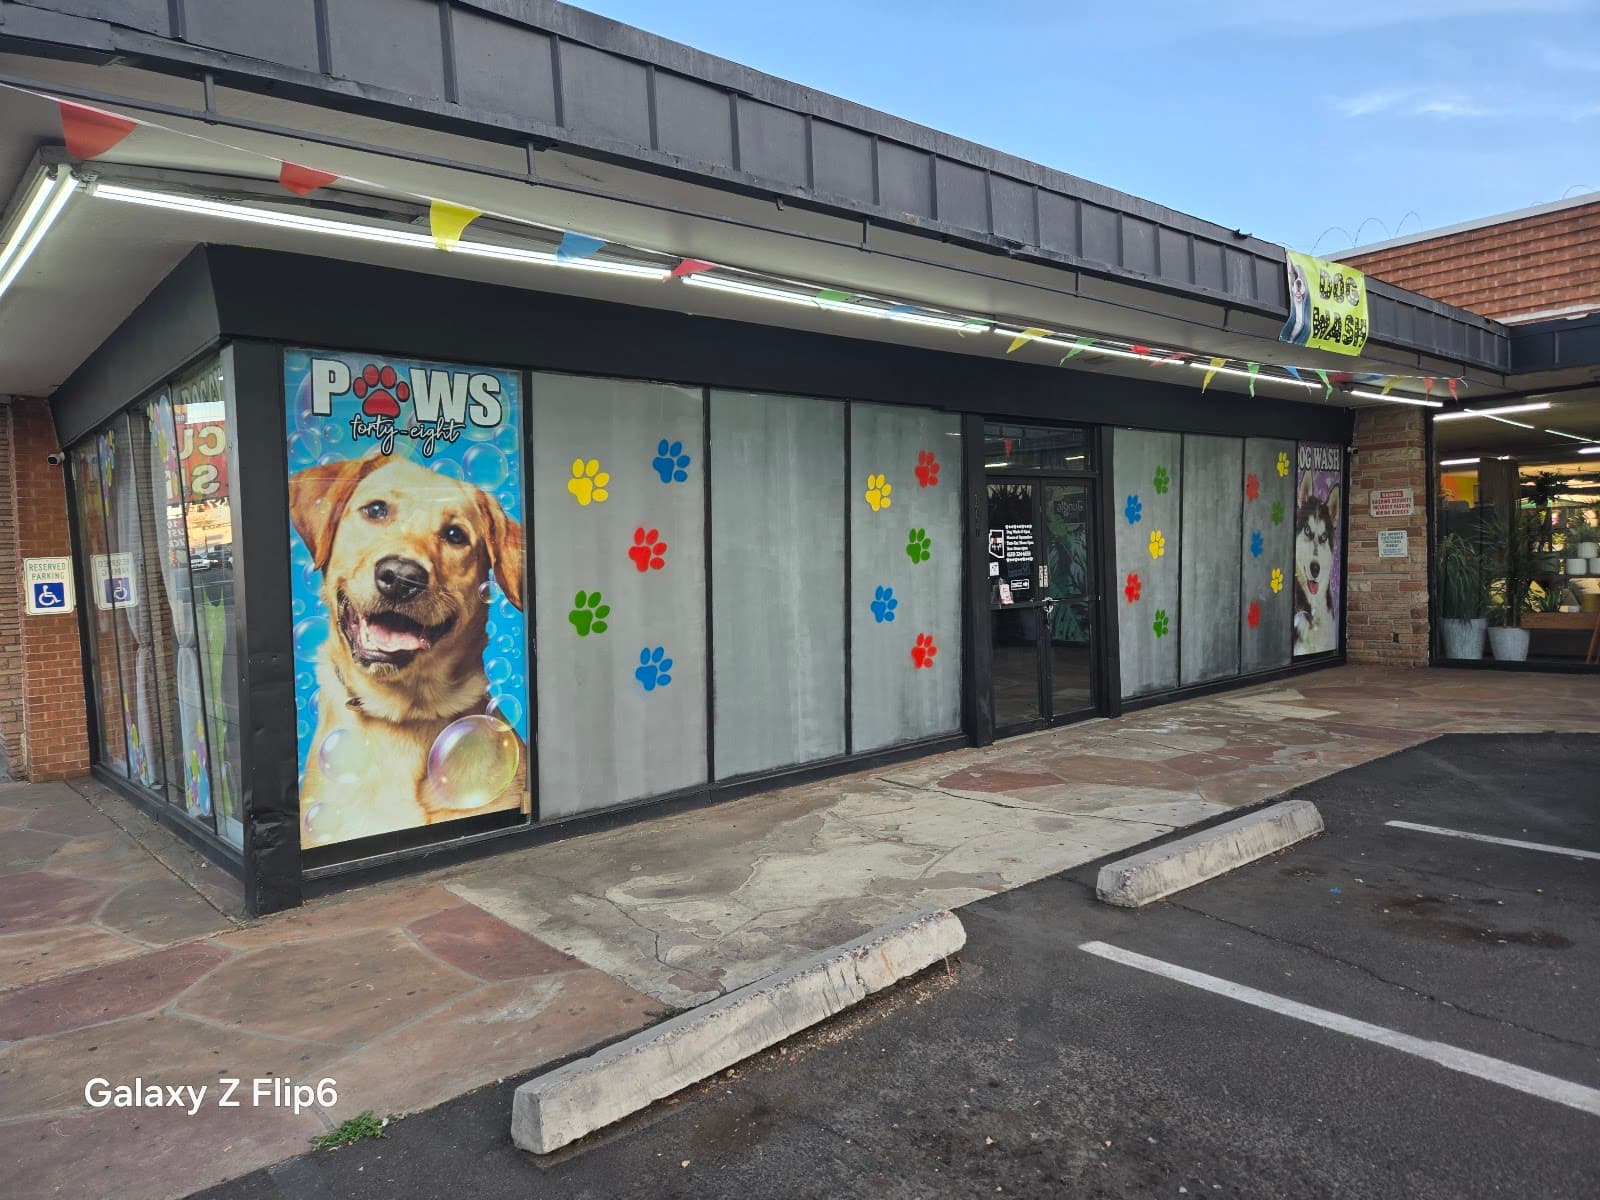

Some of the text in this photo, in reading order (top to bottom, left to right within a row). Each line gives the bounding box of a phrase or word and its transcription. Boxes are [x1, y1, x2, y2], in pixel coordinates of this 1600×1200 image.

[1319, 267, 1359, 307] DOG
[1311, 306, 1366, 348] WASH
[350, 412, 466, 456] forty-eight
[1298, 446, 1340, 470] OG WASH
[29, 562, 66, 572] RESERVED
[31, 572, 65, 580] PARKING
